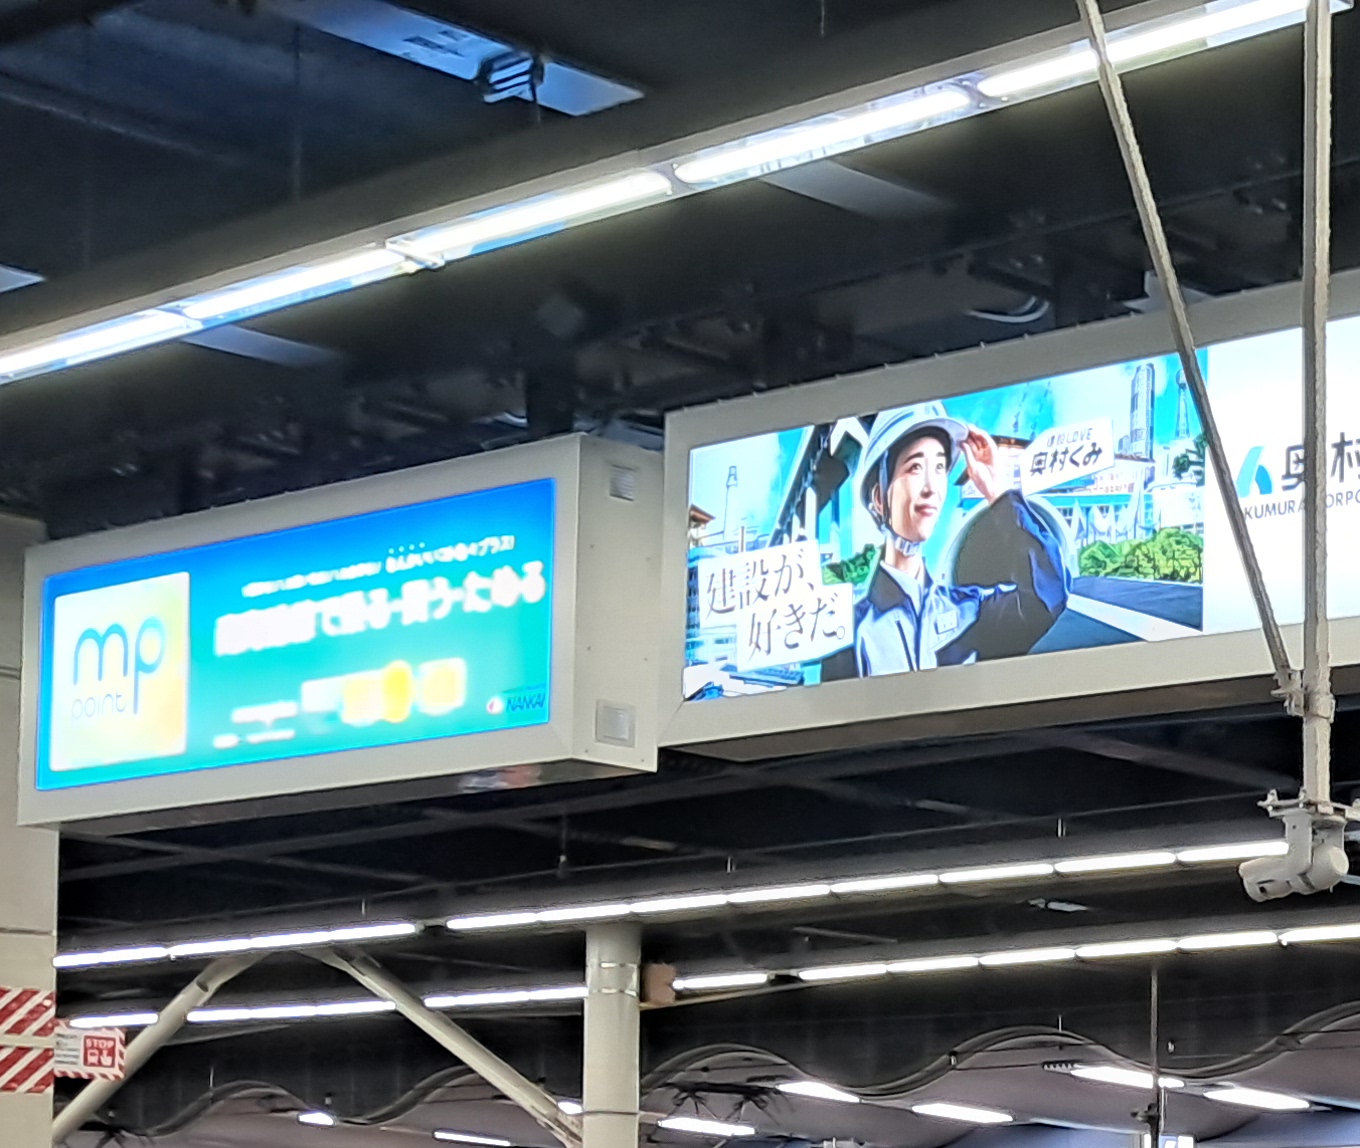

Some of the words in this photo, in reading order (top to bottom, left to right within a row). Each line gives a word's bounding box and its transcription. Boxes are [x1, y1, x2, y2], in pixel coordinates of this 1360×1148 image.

[1030, 442, 1103, 477] 奥村くみ
[1243, 499, 1305, 521] KUMURA
[748, 592, 846, 662] 好きだ。
